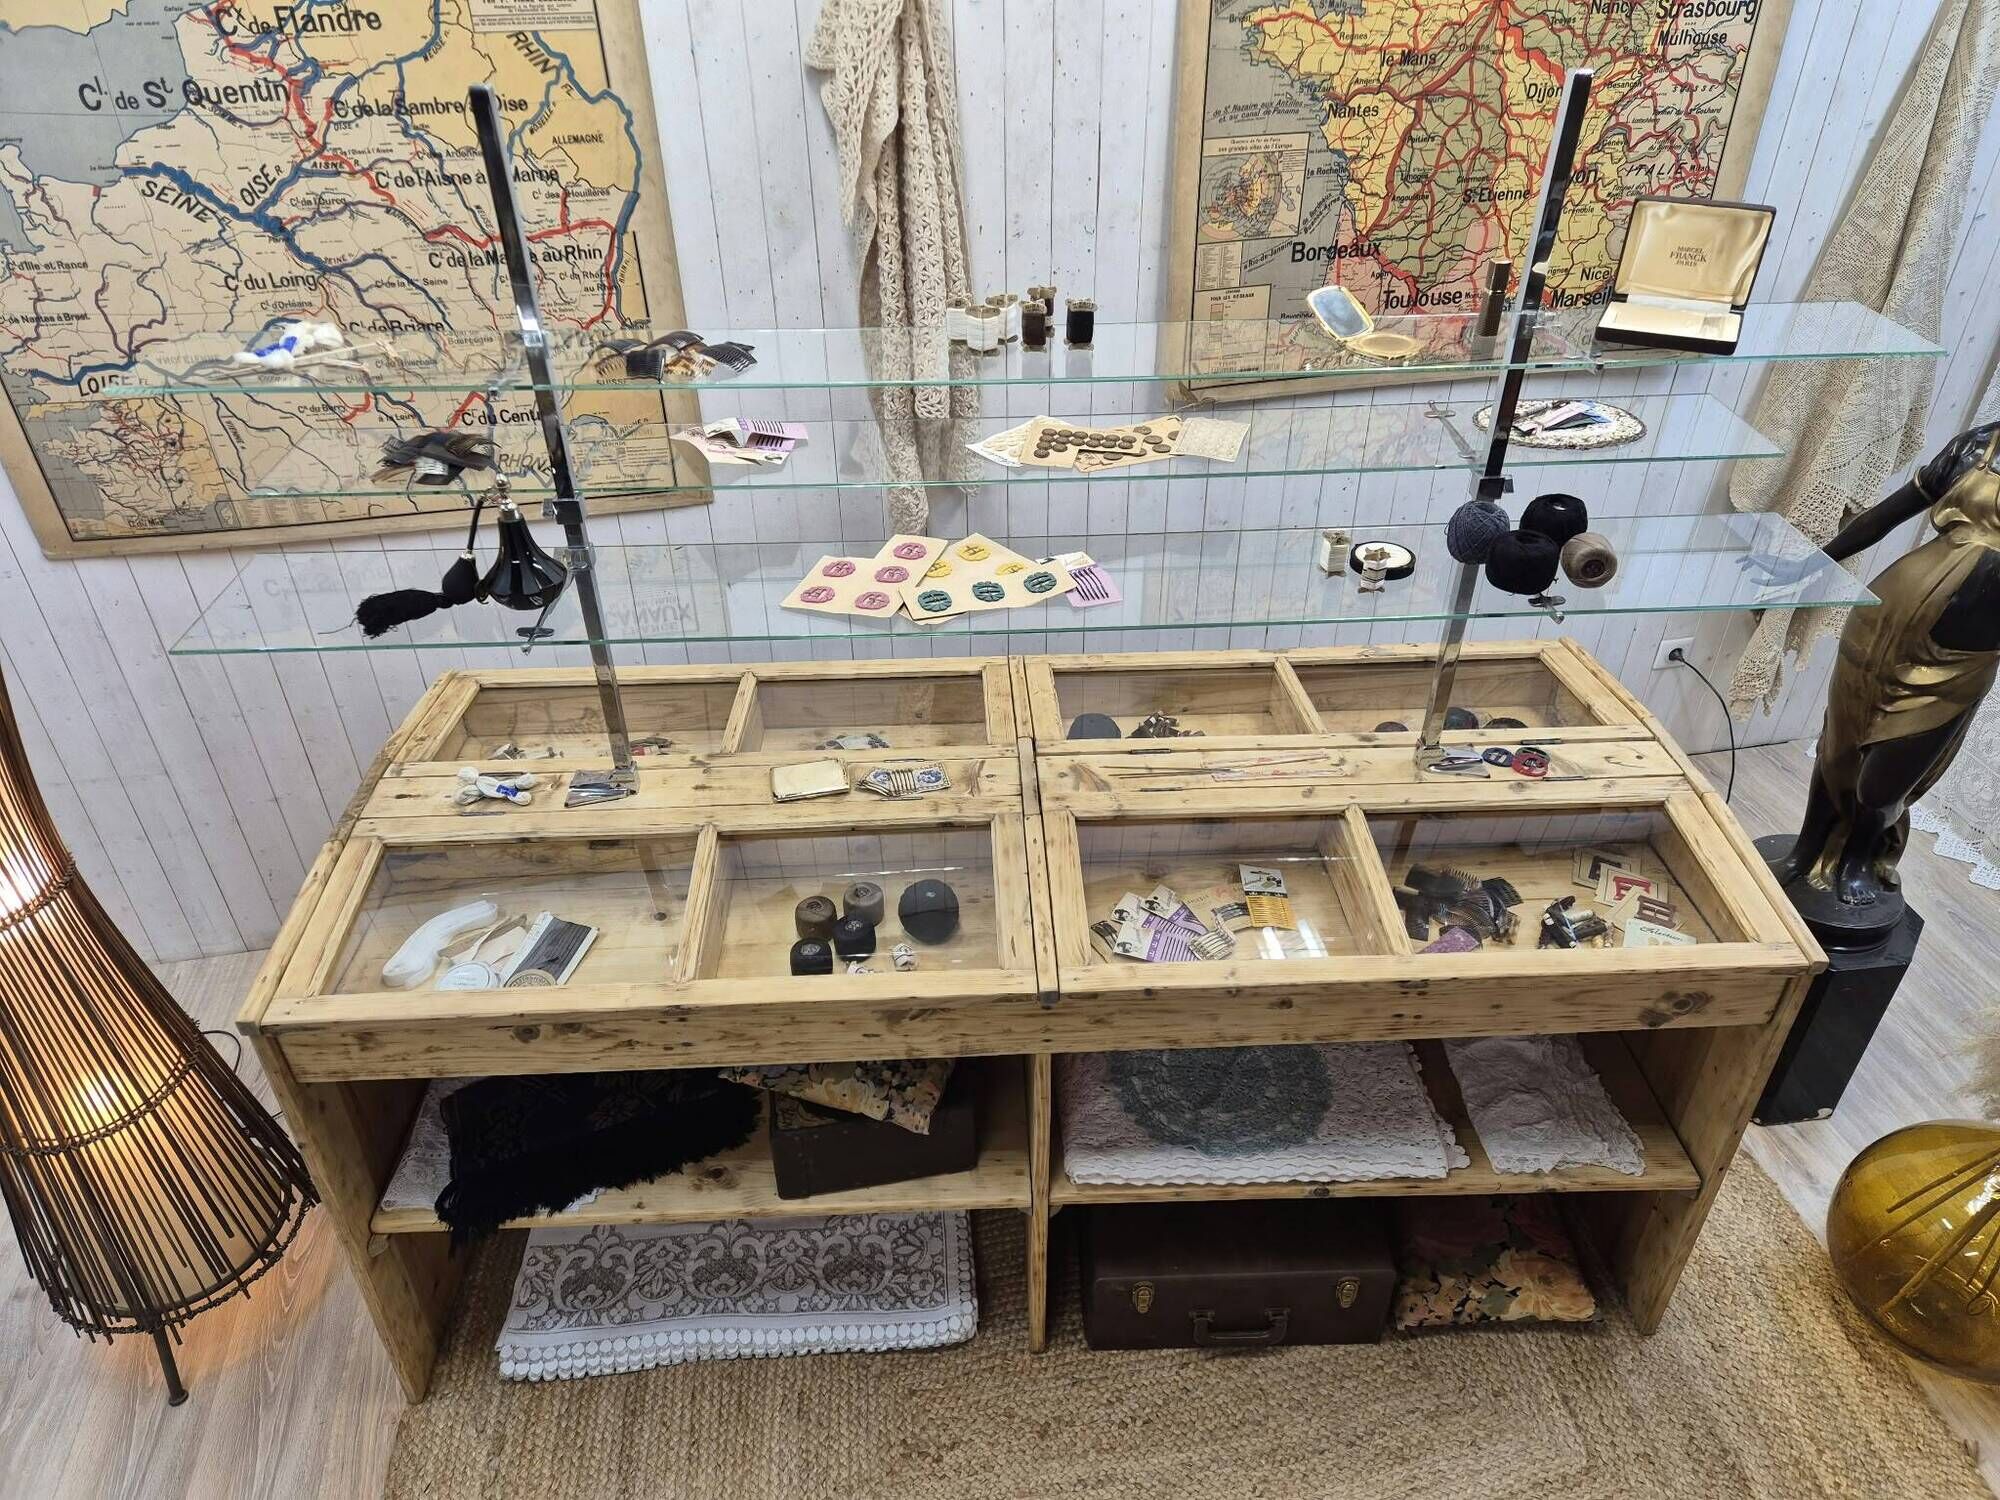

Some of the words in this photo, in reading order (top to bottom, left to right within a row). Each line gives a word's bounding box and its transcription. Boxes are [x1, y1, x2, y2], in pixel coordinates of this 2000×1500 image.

[1590, 0, 1632, 17] Nancy
[1656, 0, 1758, 23] Strasbourg
[249, 16, 271, 34] de
[273, 2, 382, 38] Flandre
[1658, 28, 1727, 46] Mulhouse
[506, 31, 559, 74] RHIN
[1381, 50, 1395, 67] le
[1400, 50, 1437, 66] Mans
[115, 90, 139, 110] de
[143, 77, 173, 108] St
[182, 77, 290, 109] Quentin
[375, 97, 393, 116] la
[396, 94, 465, 116] Sambre
[1327, 103, 1379, 119] Nantes
[552, 132, 605, 145] ALLEMAGNE
[395, 170, 415, 188] de
[1625, 161, 1688, 177] ITALIE
[240, 163, 277, 207] OISE
[141, 180, 208, 223] SEINE
[541, 249, 561, 262] au
[564, 243, 603, 261] Rhin
[1291, 238, 1381, 263] Bordeaux
[1669, 251, 1707, 262] FRANCK
[244, 273, 266, 290] du
[268, 271, 318, 292] Loing
[1580, 266, 1611, 282] Nice
[1384, 289, 1463, 310] Toulouse
